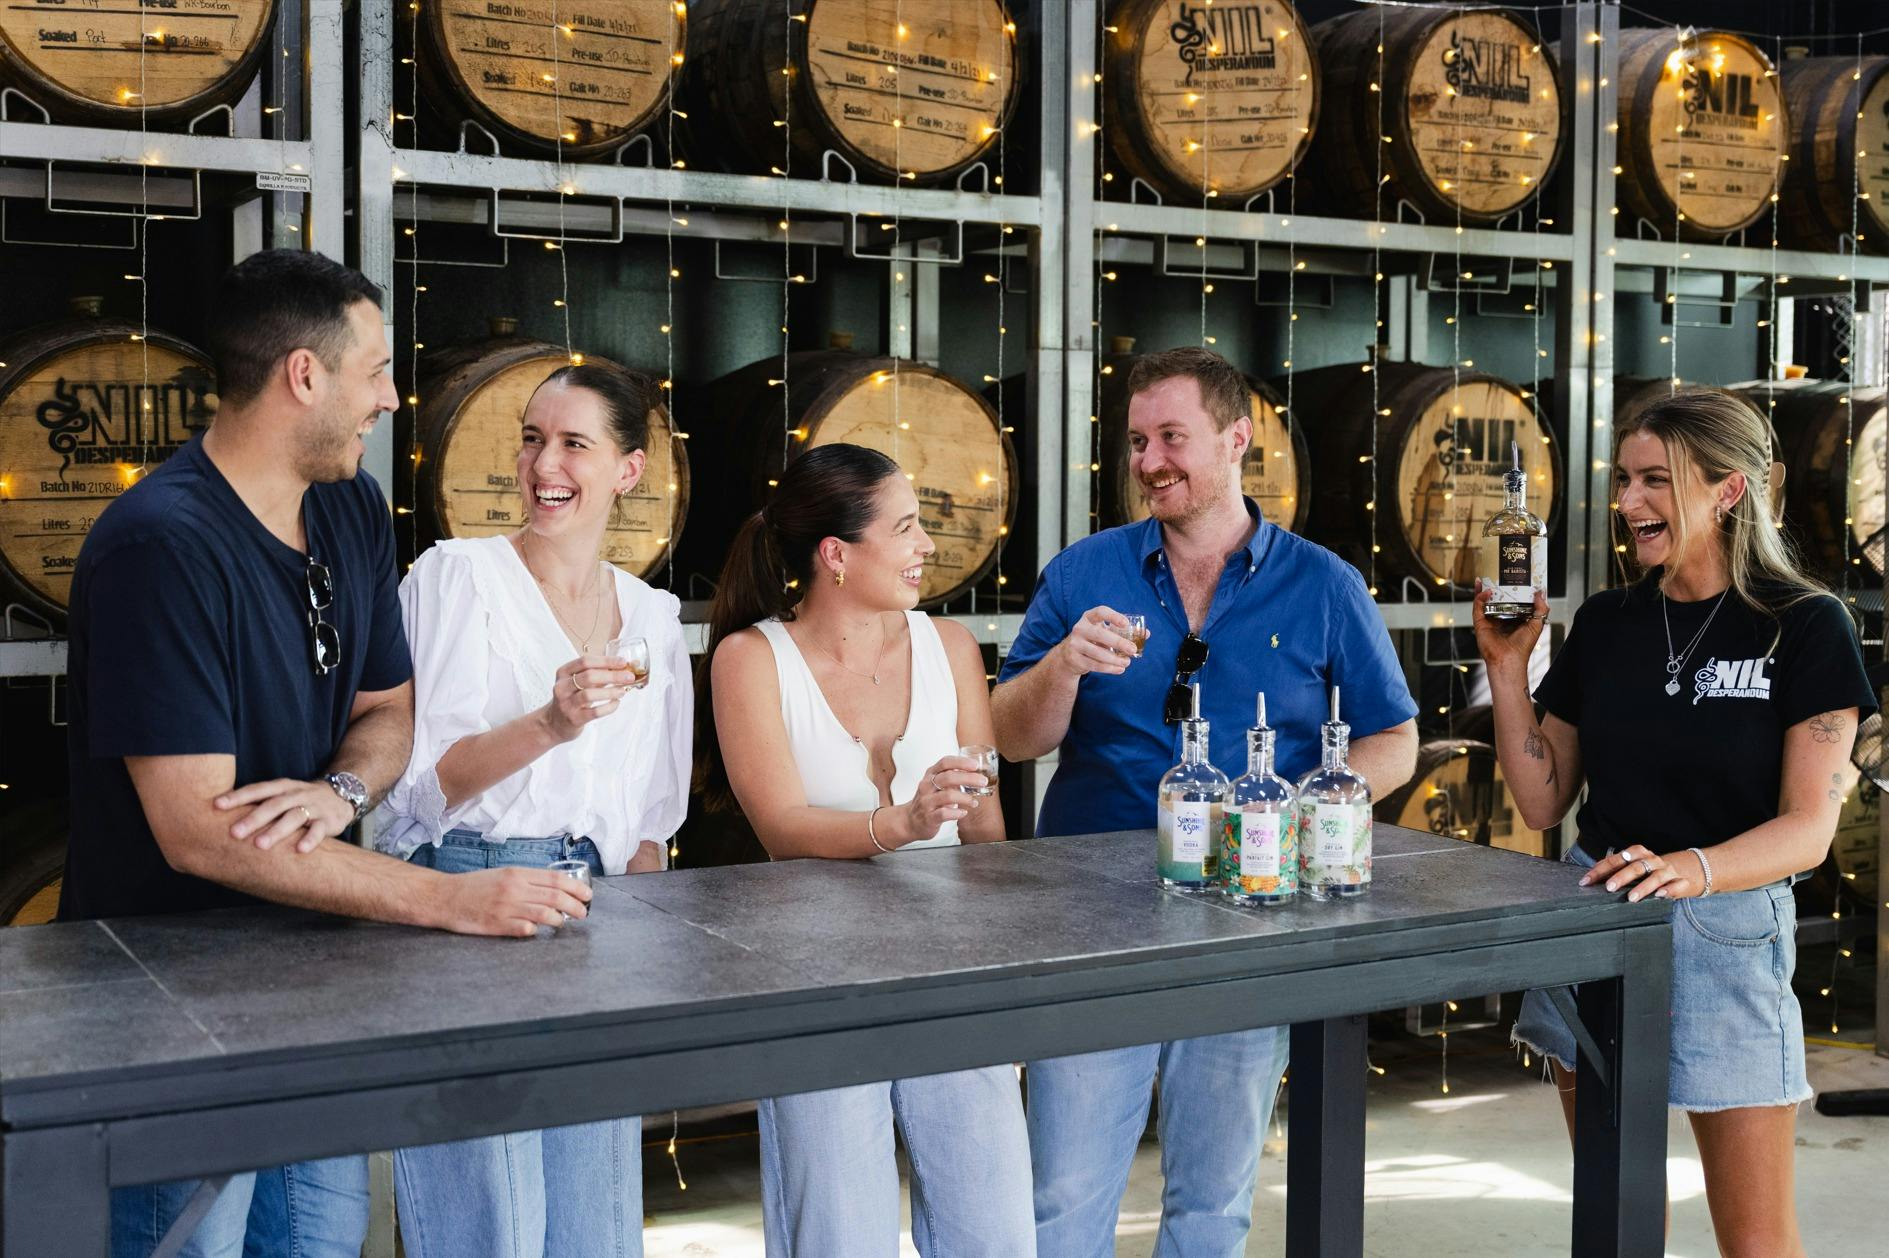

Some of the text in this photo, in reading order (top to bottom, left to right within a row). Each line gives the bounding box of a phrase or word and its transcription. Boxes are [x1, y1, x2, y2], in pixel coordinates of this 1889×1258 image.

[487, 2, 512, 16] Batch
[573, 14, 586, 25] Fill
[587, 17, 606, 29] Date
[38, 28, 77, 43] Soaked
[1190, 6, 1275, 58] NIL
[486, 36, 511, 51] Litres
[572, 48, 603, 62] Pre-use
[1195, 55, 1276, 72] DESPERANDUM
[1460, 37, 1530, 91] NIL
[879, 76, 898, 89] 205
[1696, 69, 1759, 117] NIL
[41, 482, 69, 493] Batch
[72, 482, 86, 492] No
[487, 474, 514, 487] Batch
[487, 509, 511, 521] Litres
[42, 519, 71, 530] Litres
[1714, 658, 1770, 690] NIL
[1707, 688, 1770, 700] DESPERANDUM
